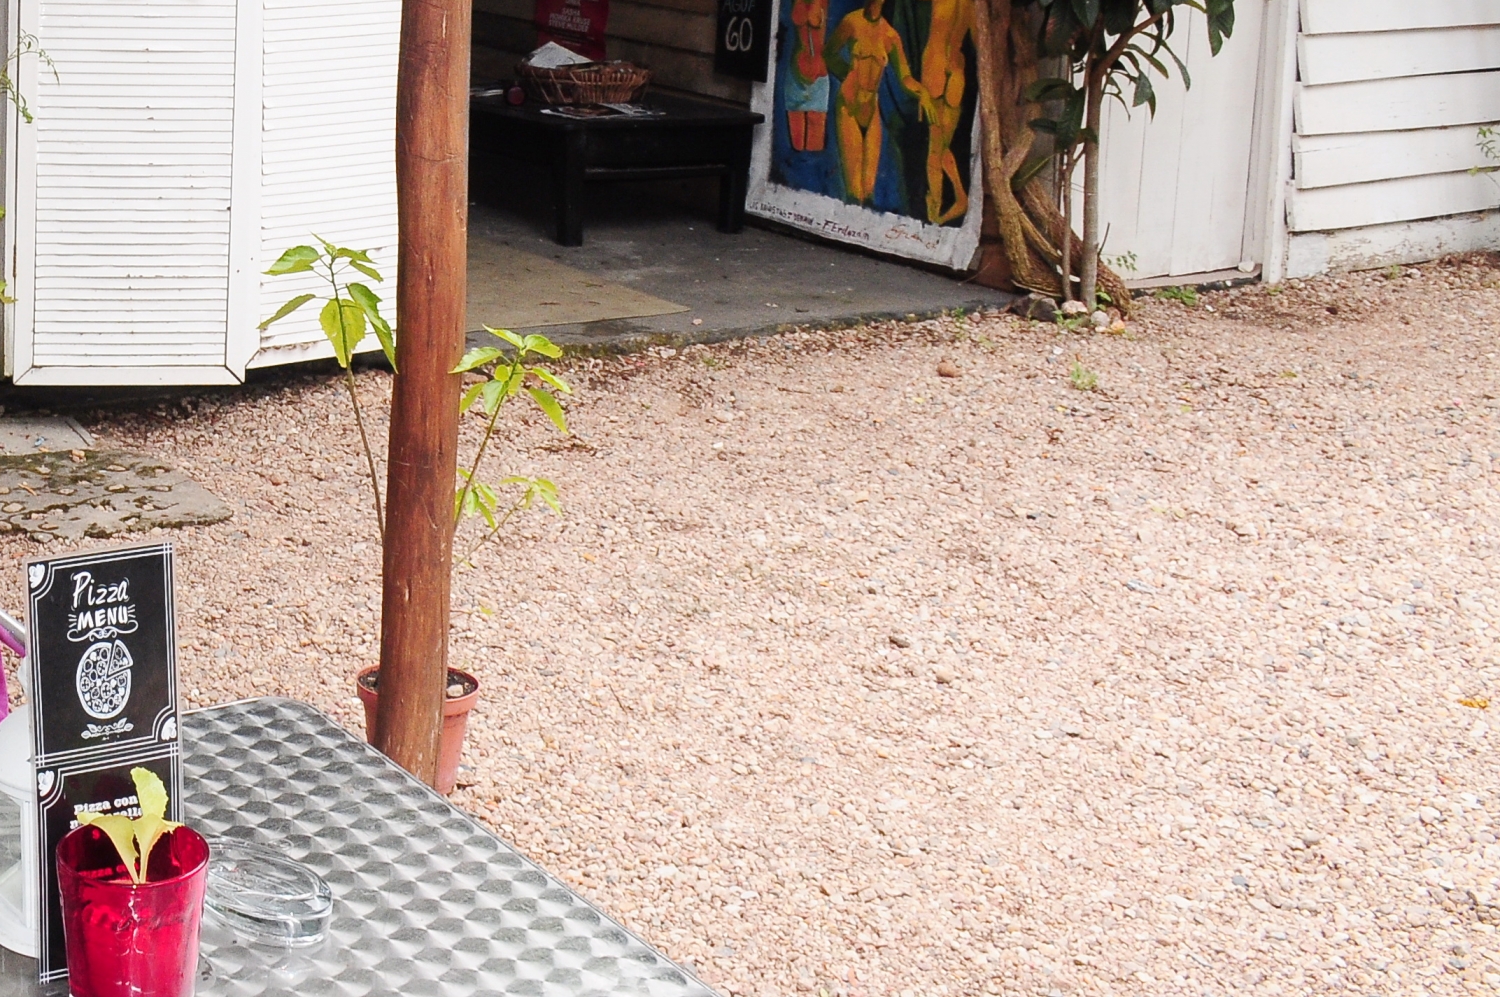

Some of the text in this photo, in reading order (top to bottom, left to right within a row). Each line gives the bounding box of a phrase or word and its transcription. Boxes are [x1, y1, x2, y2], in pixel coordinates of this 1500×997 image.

[725, 16, 754, 52] 60
[72, 571, 129, 608] Pizza
[77, 605, 129, 631] MENU
[73, 794, 139, 816] Pizza con
